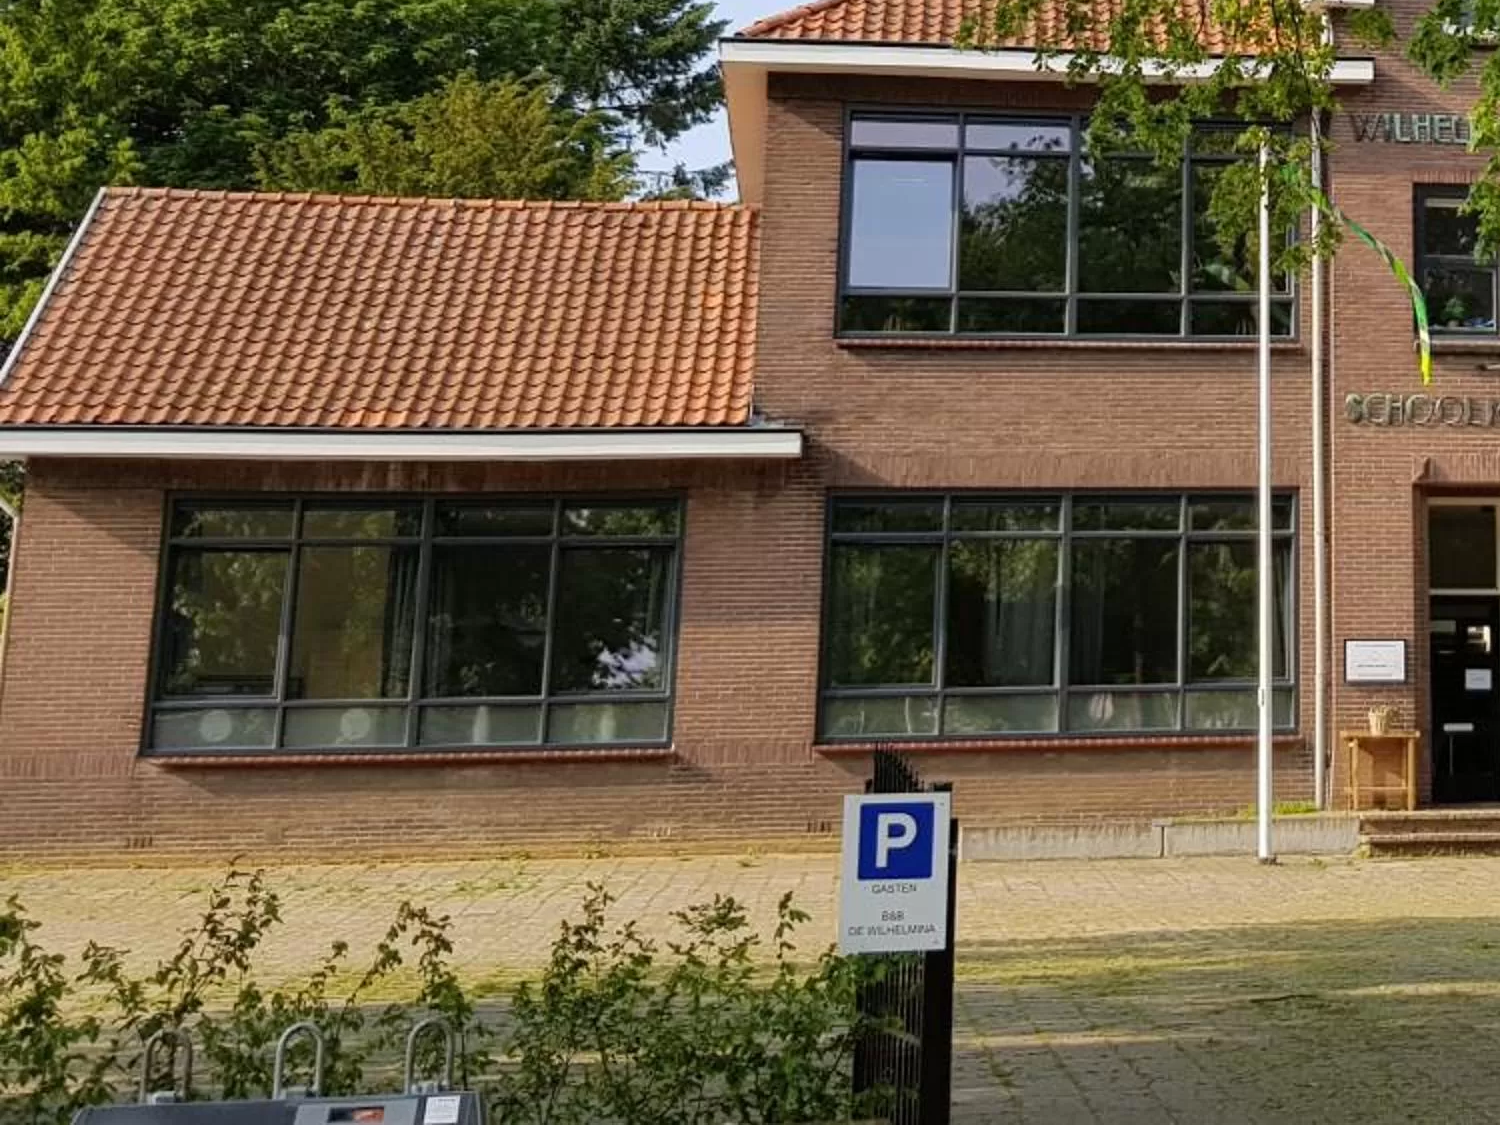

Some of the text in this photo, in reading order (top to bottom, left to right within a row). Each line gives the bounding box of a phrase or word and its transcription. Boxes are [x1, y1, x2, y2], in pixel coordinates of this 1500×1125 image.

[1345, 393, 1481, 427] SCHOOL
[875, 812, 917, 868] P
[871, 882, 917, 894] GASTEN
[881, 910, 905, 922] B&B
[847, 923, 936, 937] DE WILHELMINA
